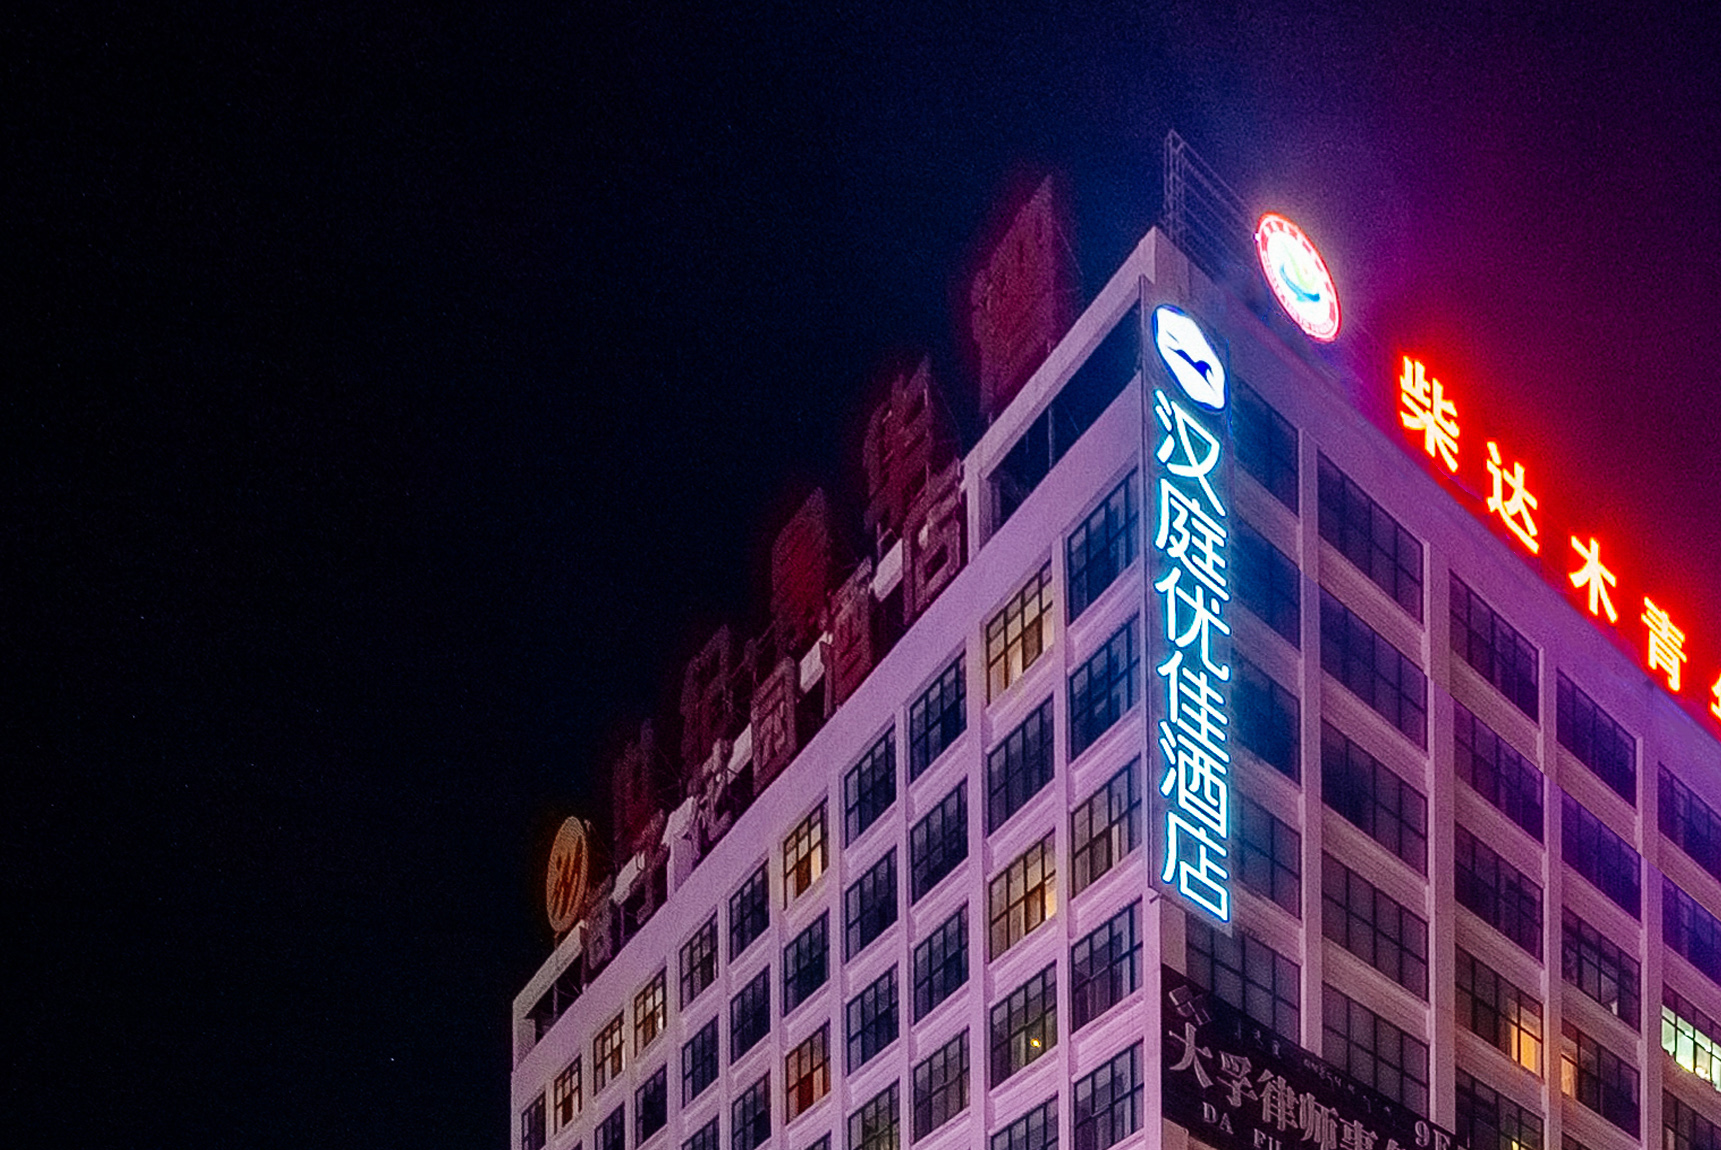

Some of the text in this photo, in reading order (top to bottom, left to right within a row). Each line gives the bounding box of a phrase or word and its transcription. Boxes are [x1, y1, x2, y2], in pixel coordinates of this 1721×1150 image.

[1155, 388, 1231, 922] 汉庭优佳酒店
[1202, 1101, 1234, 1135] DA
